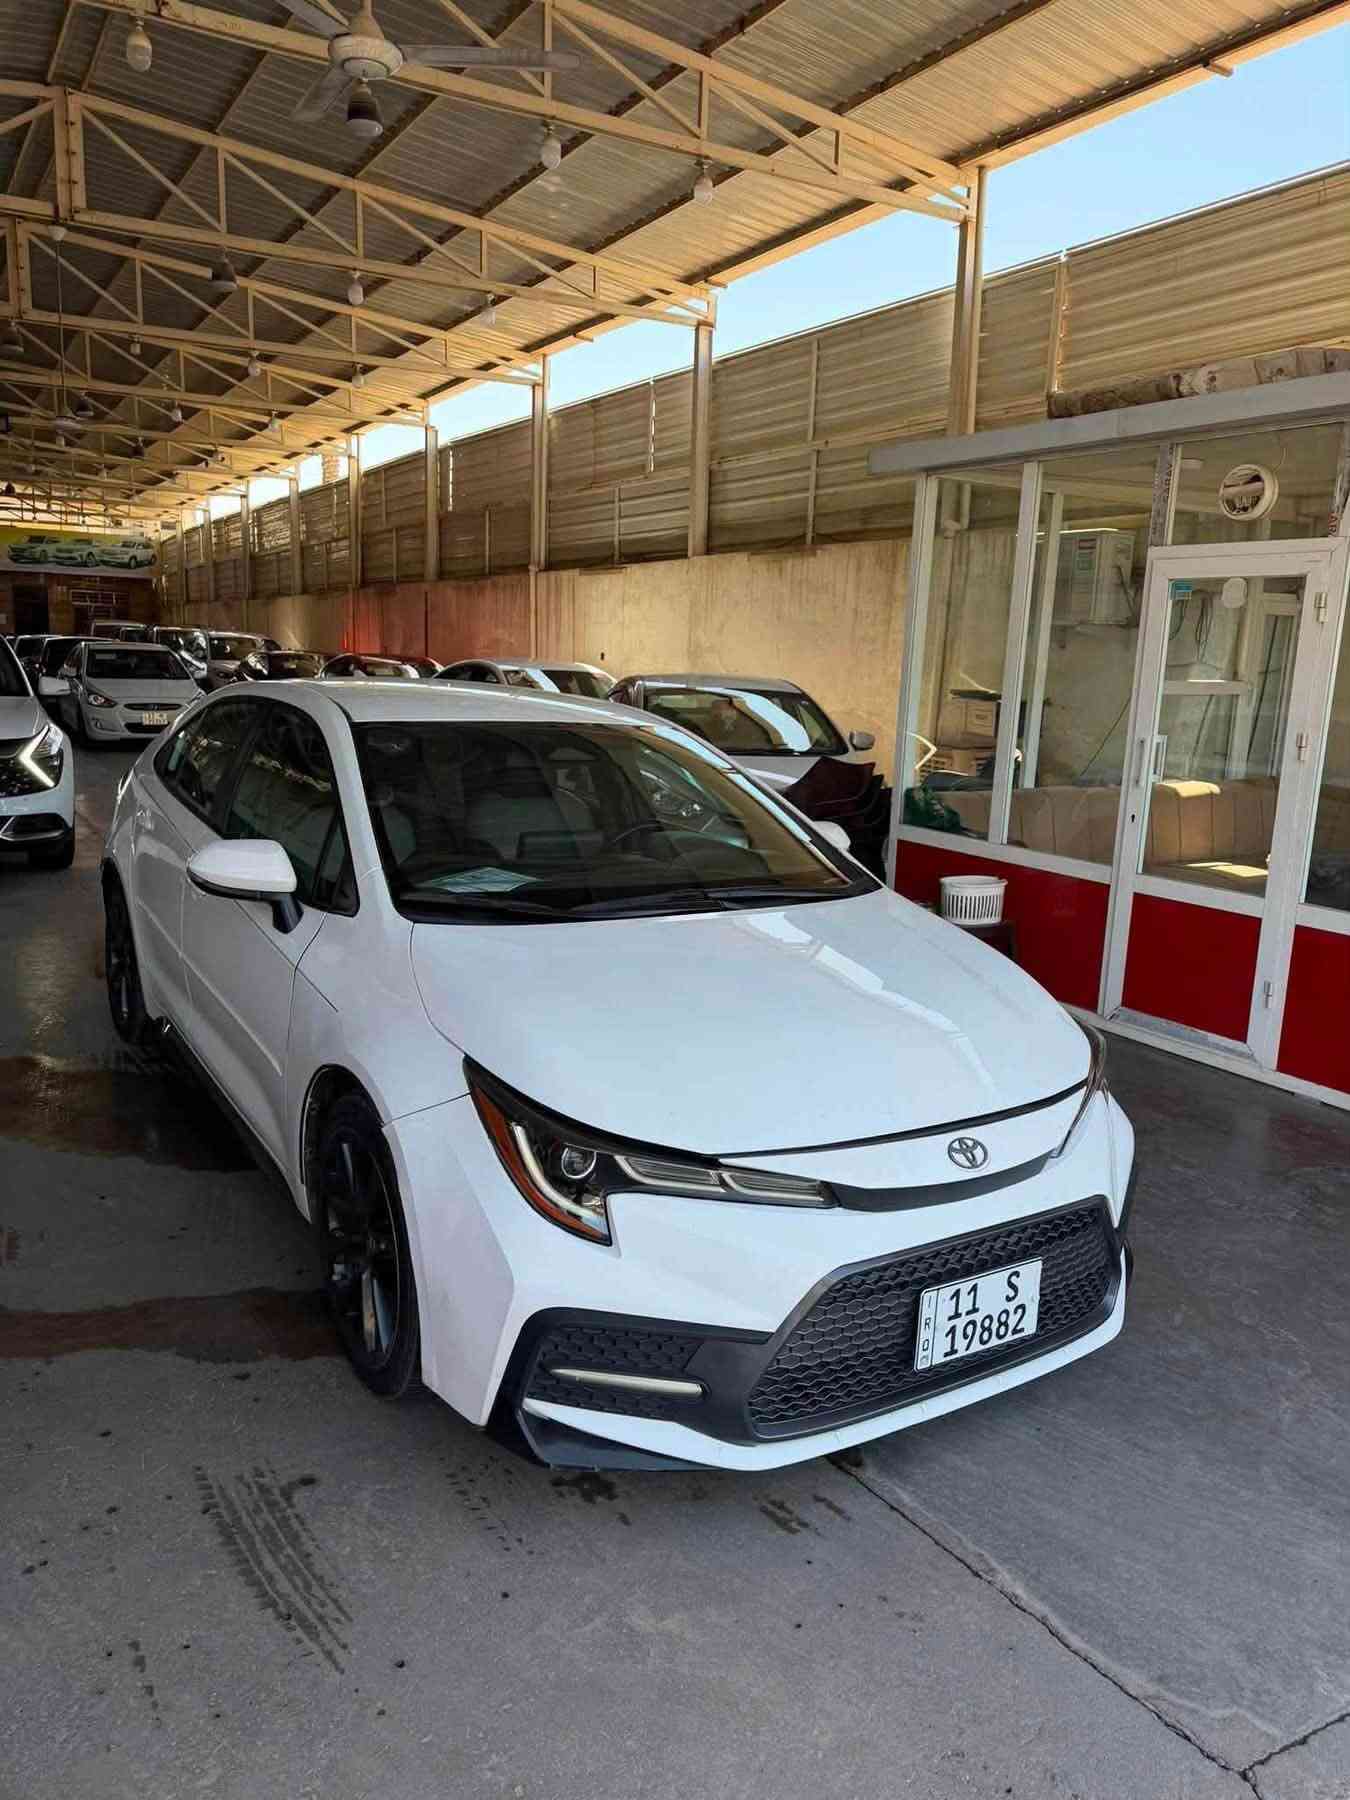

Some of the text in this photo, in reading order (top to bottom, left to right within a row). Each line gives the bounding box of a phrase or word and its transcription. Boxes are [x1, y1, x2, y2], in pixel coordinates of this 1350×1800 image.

[947, 1270, 1020, 1321] 11 S
[944, 1303, 1027, 1358] 19882
